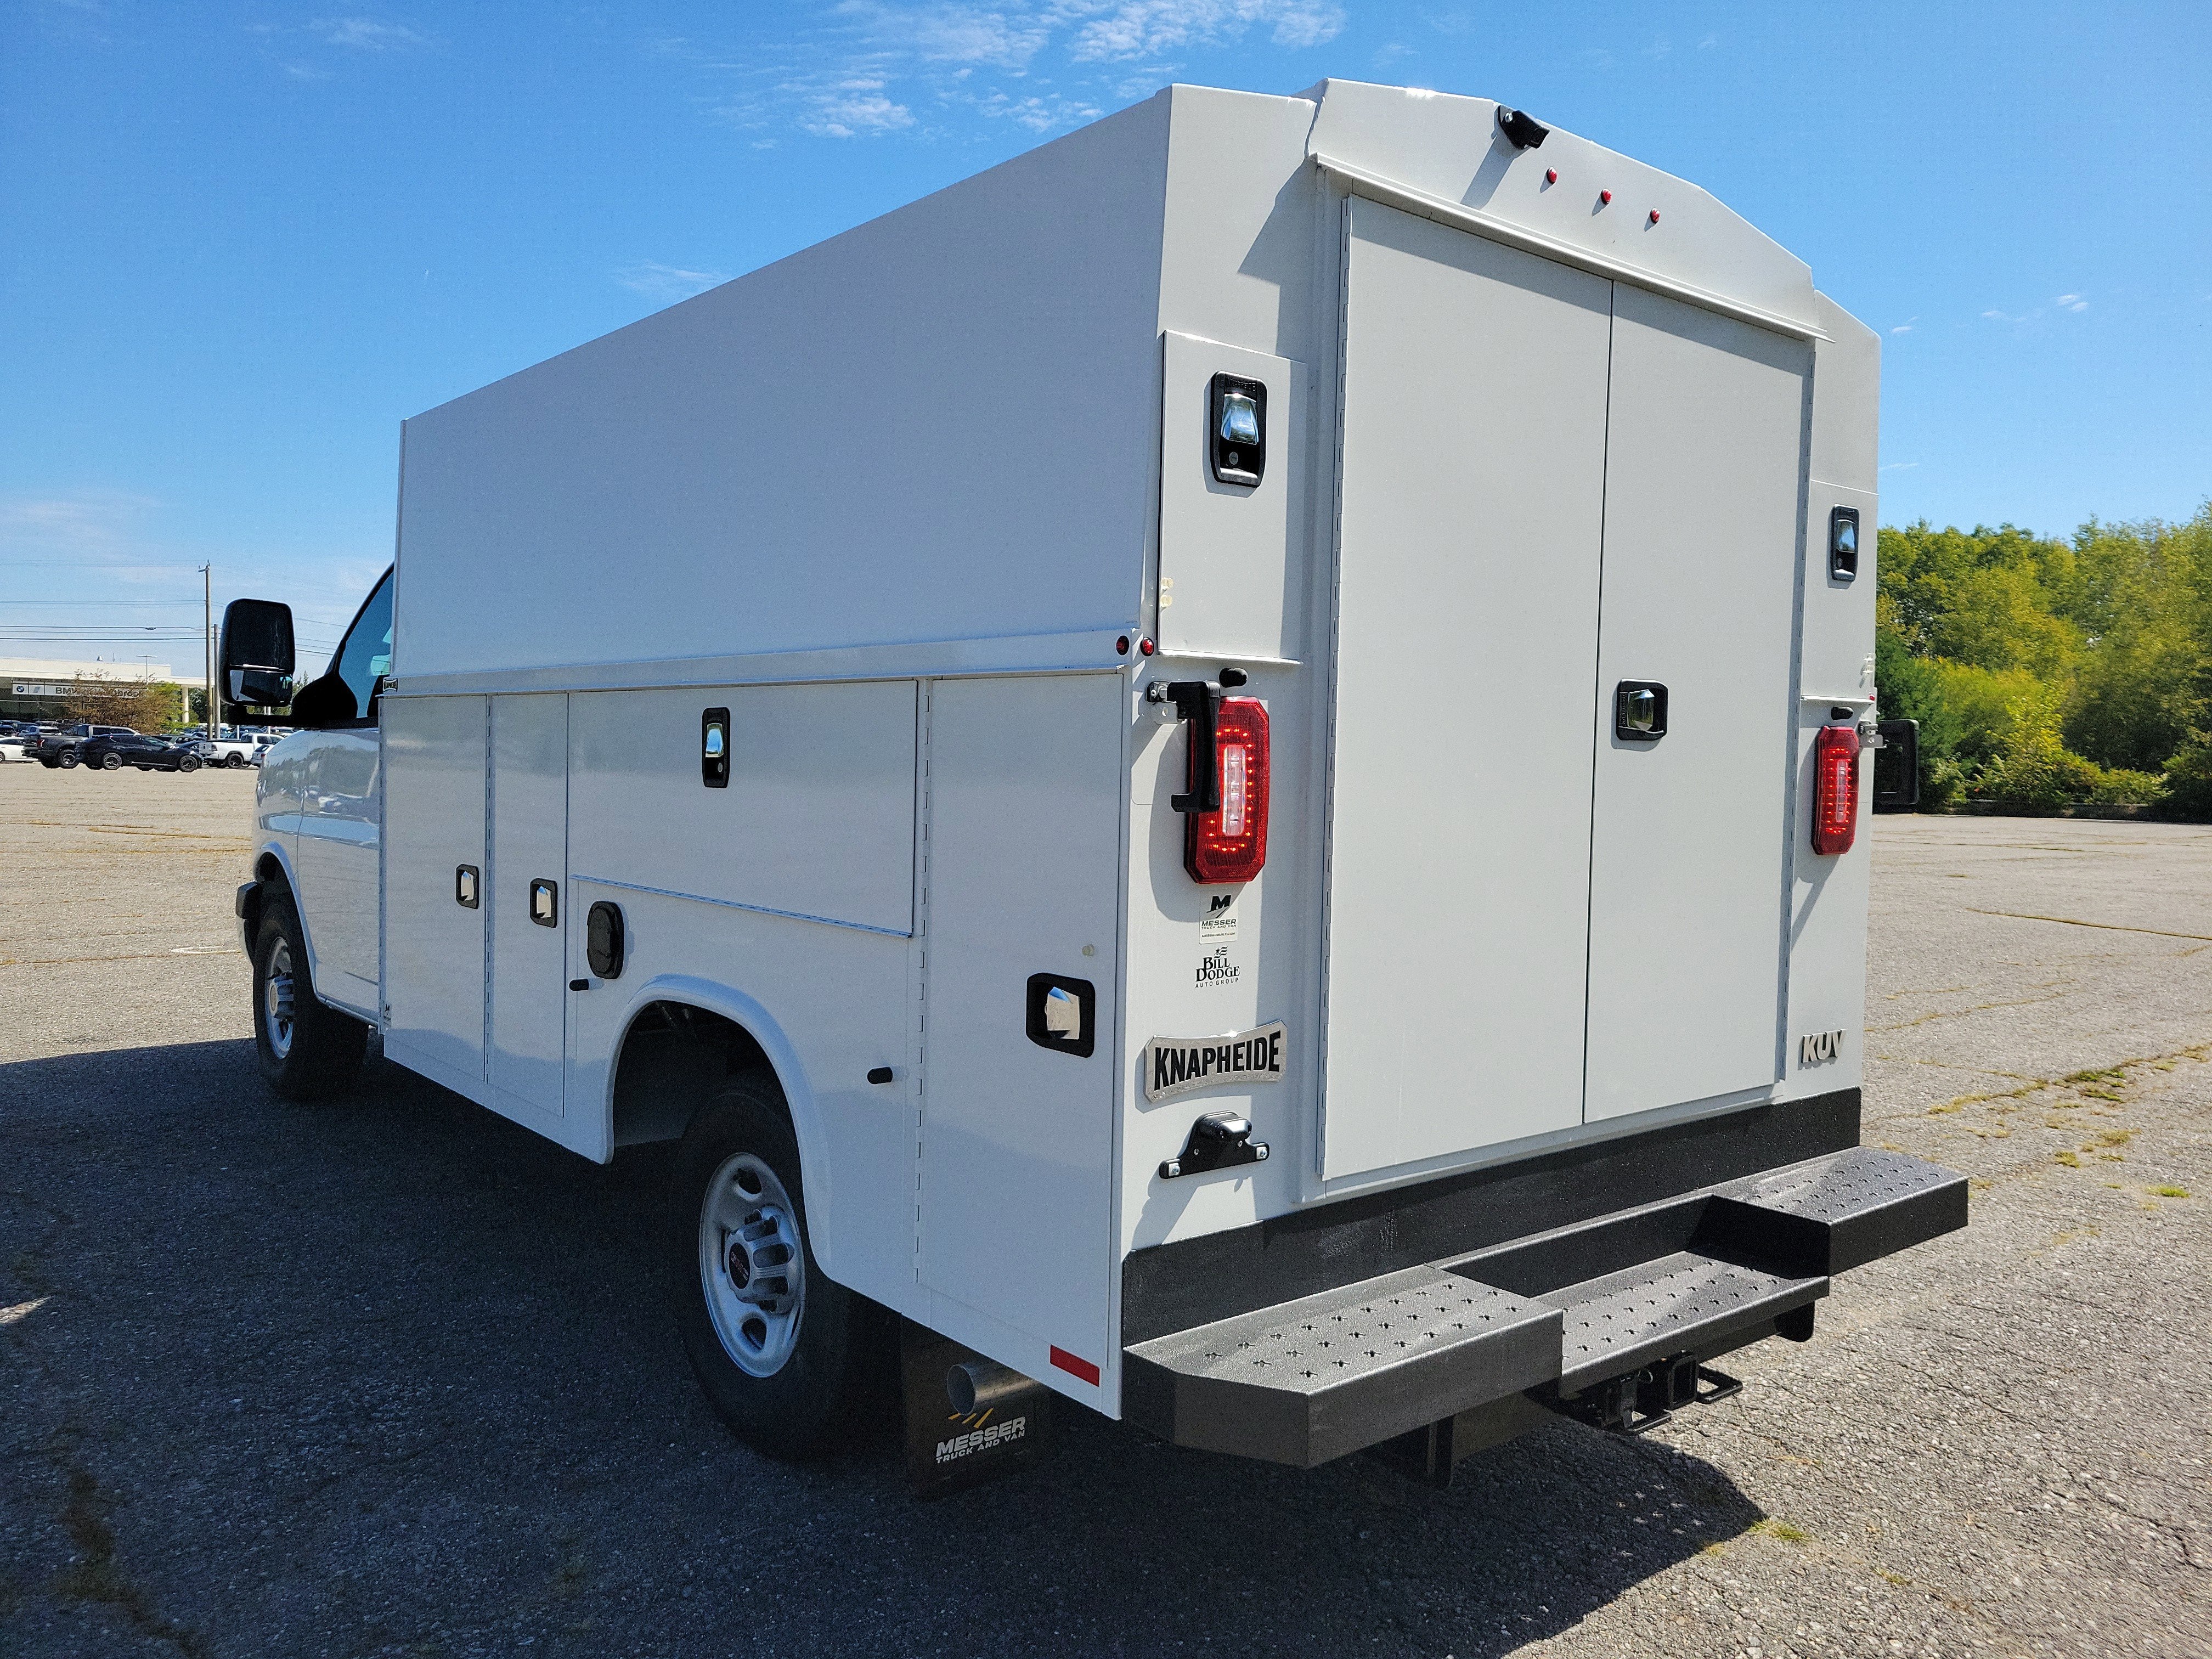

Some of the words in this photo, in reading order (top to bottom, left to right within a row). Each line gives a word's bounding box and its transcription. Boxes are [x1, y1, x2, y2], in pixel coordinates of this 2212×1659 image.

[1201, 918, 1237, 927] MESSER
[1195, 966, 1240, 981] DODGE
[1203, 957, 1231, 969] BILL
[1154, 1030, 1281, 1091] KNAPHEIDE
[1801, 1029, 1847, 1063] KUV
[936, 1416, 1026, 1457] MESSER
[936, 1447, 973, 1464] TRUCK
[977, 1438, 1000, 1451] AND
[1005, 1430, 1025, 1442] VAN
